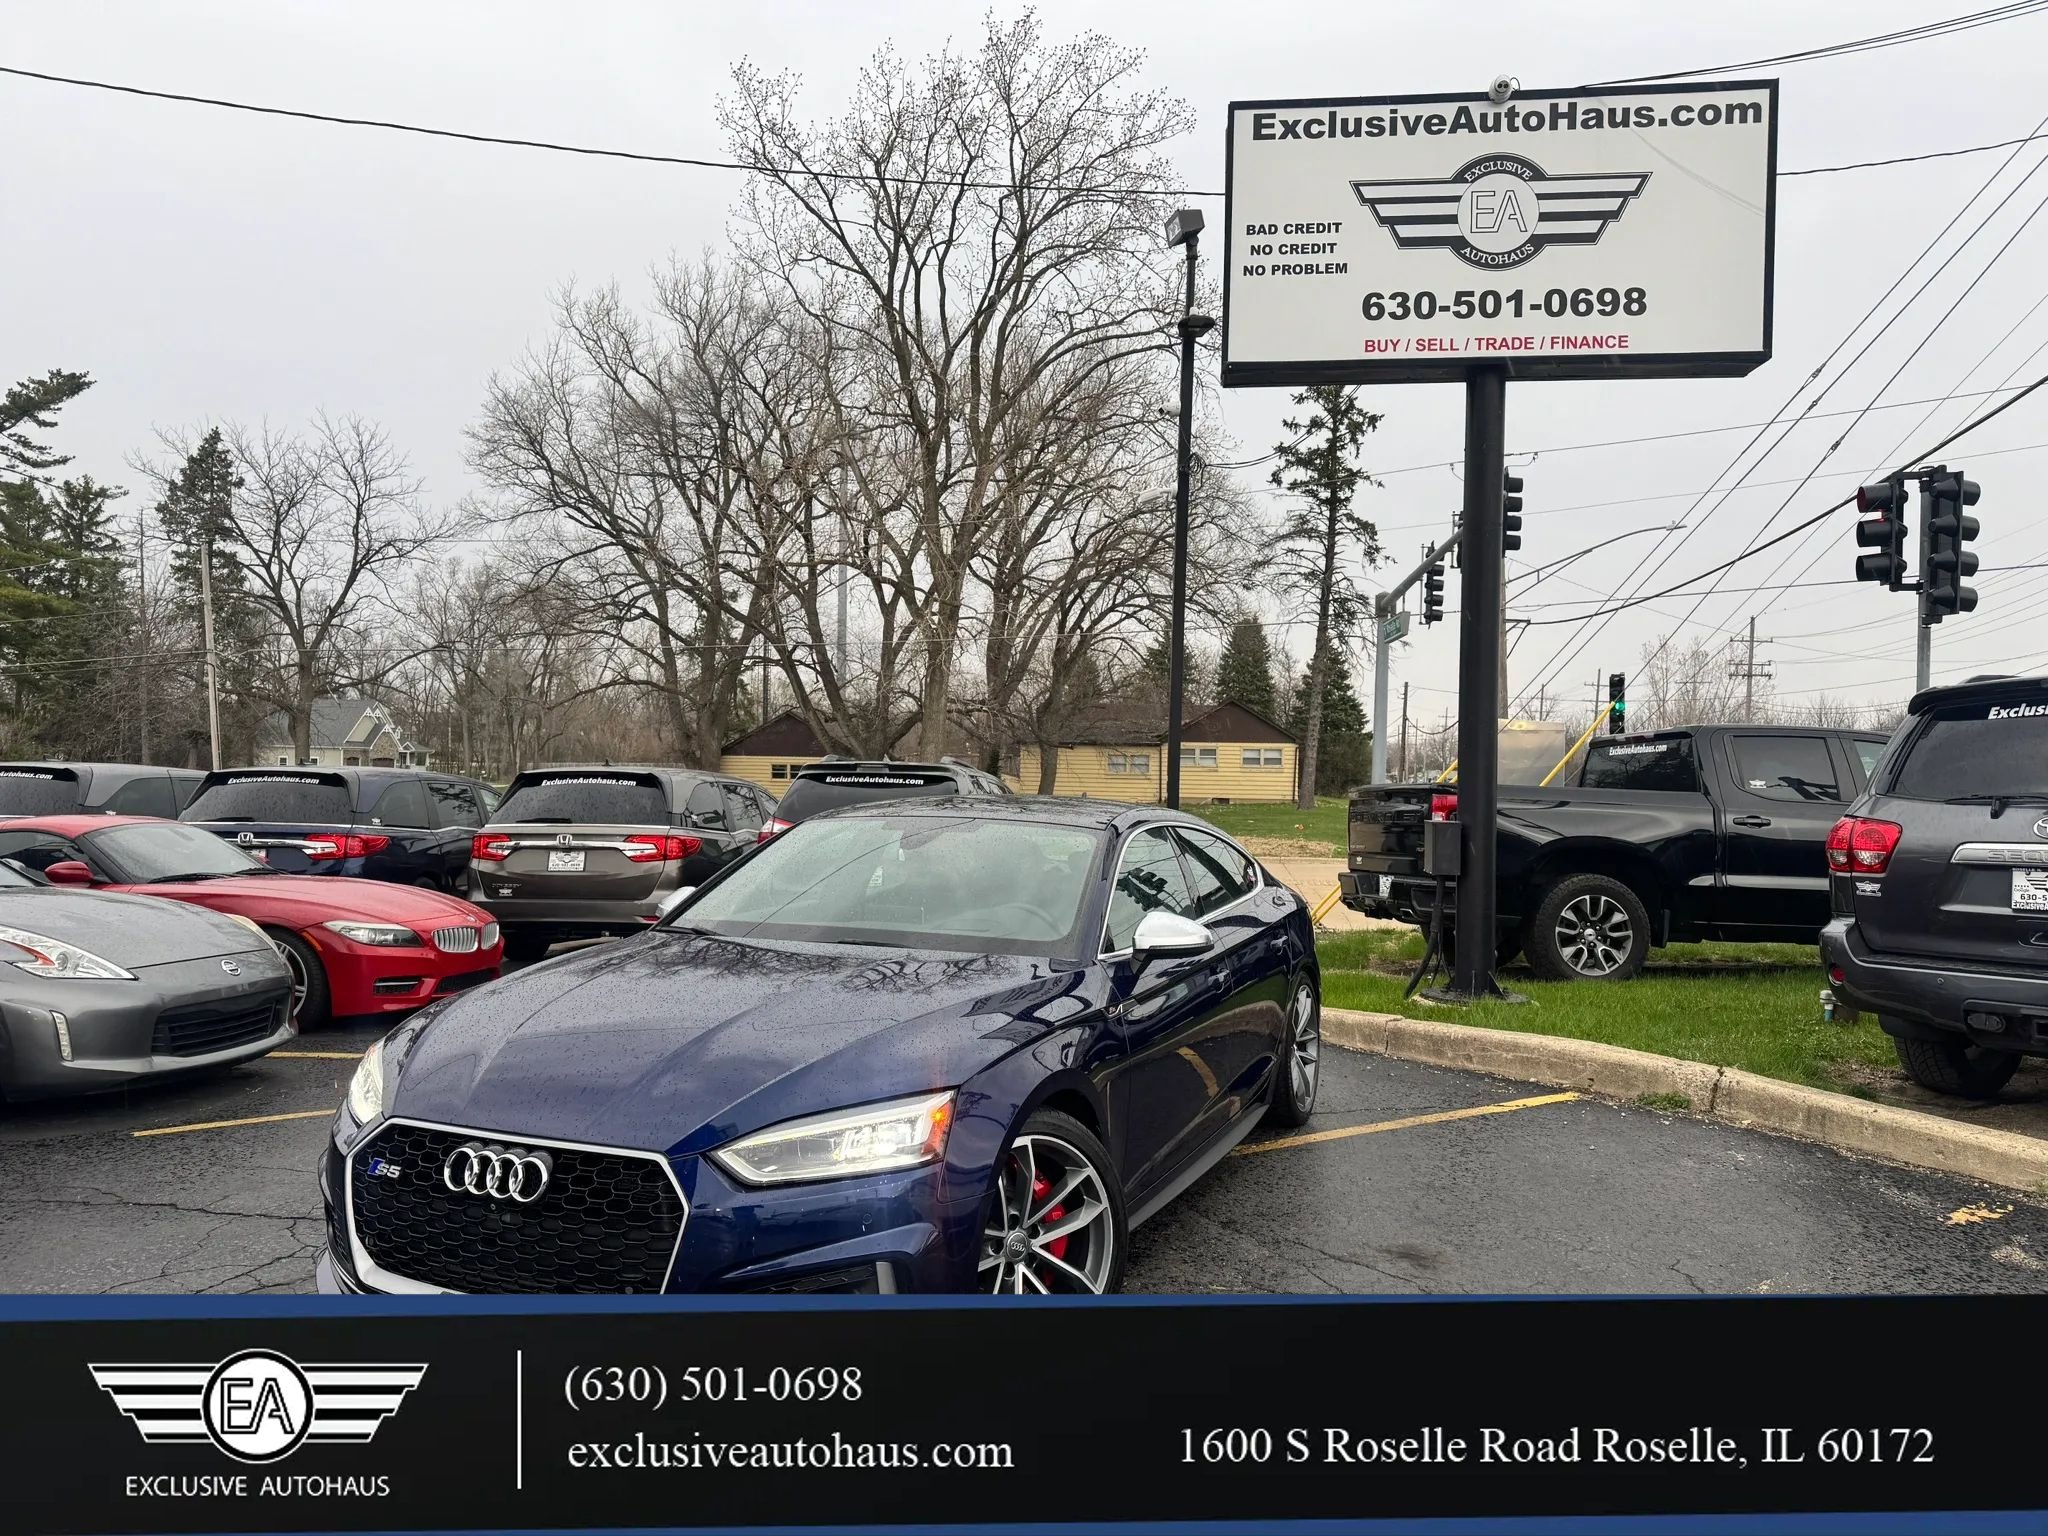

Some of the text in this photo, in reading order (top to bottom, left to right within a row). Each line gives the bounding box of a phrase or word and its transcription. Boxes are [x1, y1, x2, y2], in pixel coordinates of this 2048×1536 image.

[1252, 101, 1762, 141] ExclusiveAutoHaus.com
[1464, 161, 1533, 182] EXCLUSIVE
[1470, 189, 1528, 234] EA
[1246, 222, 1343, 236] BAD CREDIT
[1250, 242, 1338, 256] NO CREDIT
[1460, 243, 1535, 265] AUTOHAUS
[1243, 262, 1348, 276] NO PROBLEM
[1361, 287, 1647, 321] 630-501-0698
[1364, 338, 1401, 353] BUY
[1415, 338, 1460, 352] SELL
[1474, 336, 1535, 351] TRADE
[1550, 335, 1630, 350] FINANCE
[228, 776, 320, 784] ExclusiveAutohaus.com
[541, 777, 637, 787] ExclusiveAutohaus.com
[825, 775, 924, 785] ExclusiveAutohaus.com
[375, 1162, 402, 1178] S5
